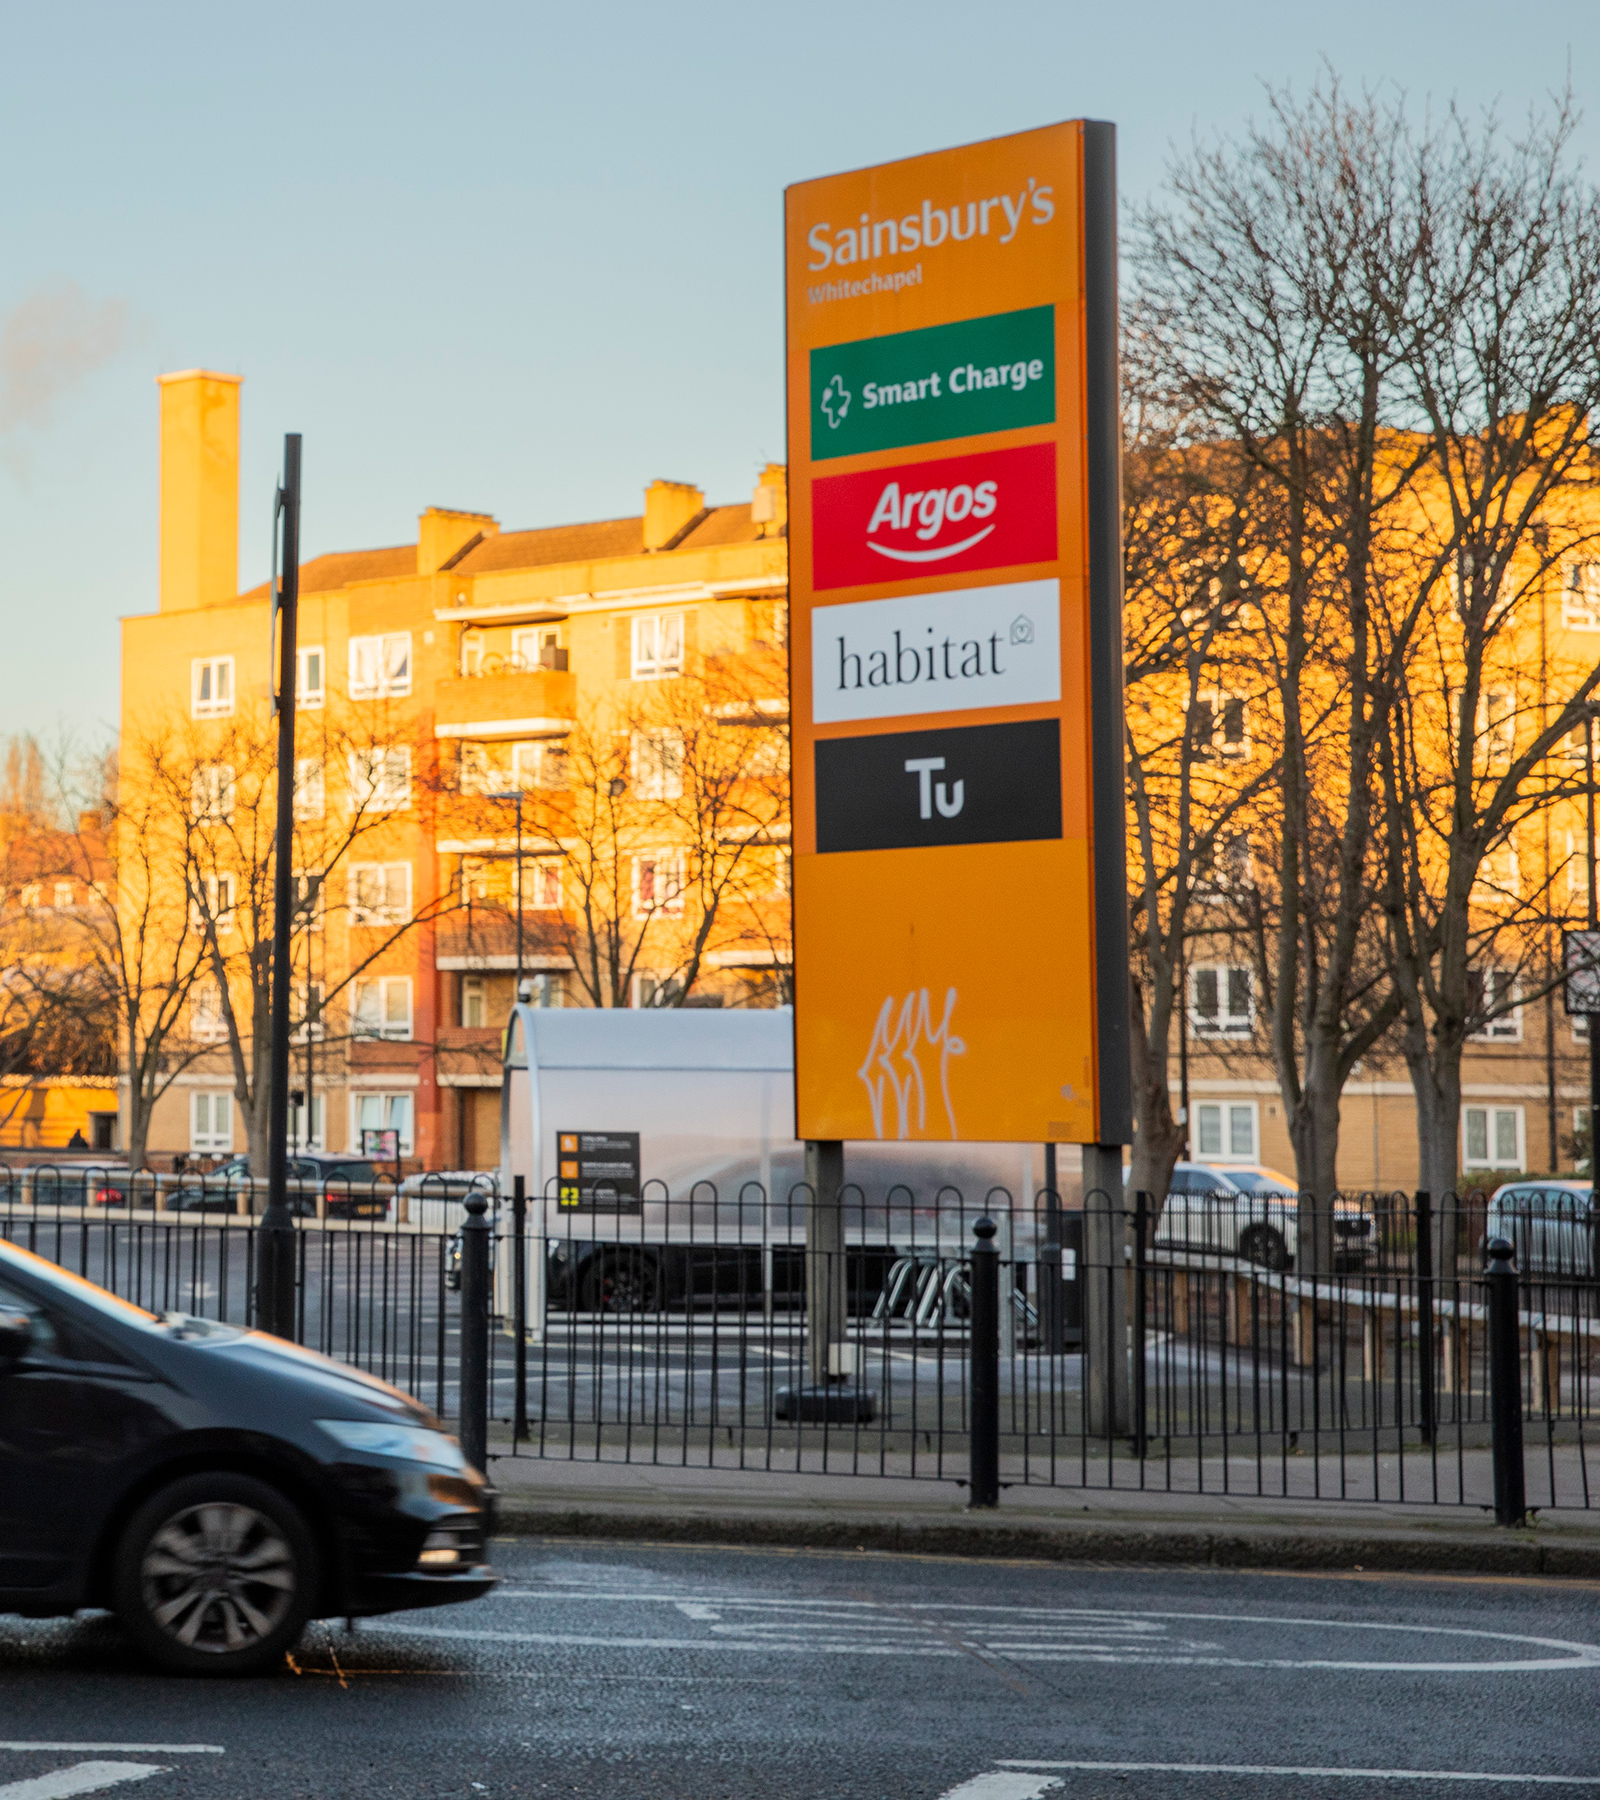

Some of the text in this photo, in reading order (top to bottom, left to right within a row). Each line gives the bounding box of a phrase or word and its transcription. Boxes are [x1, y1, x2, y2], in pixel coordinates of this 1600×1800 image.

[806, 176, 1056, 272] Sainsbury's
[806, 262, 923, 305] Whitechapel
[861, 358, 1044, 410] Smart Charge
[866, 480, 998, 541] Argos
[836, 626, 1007, 691] habitat
[903, 756, 966, 821] Tu
